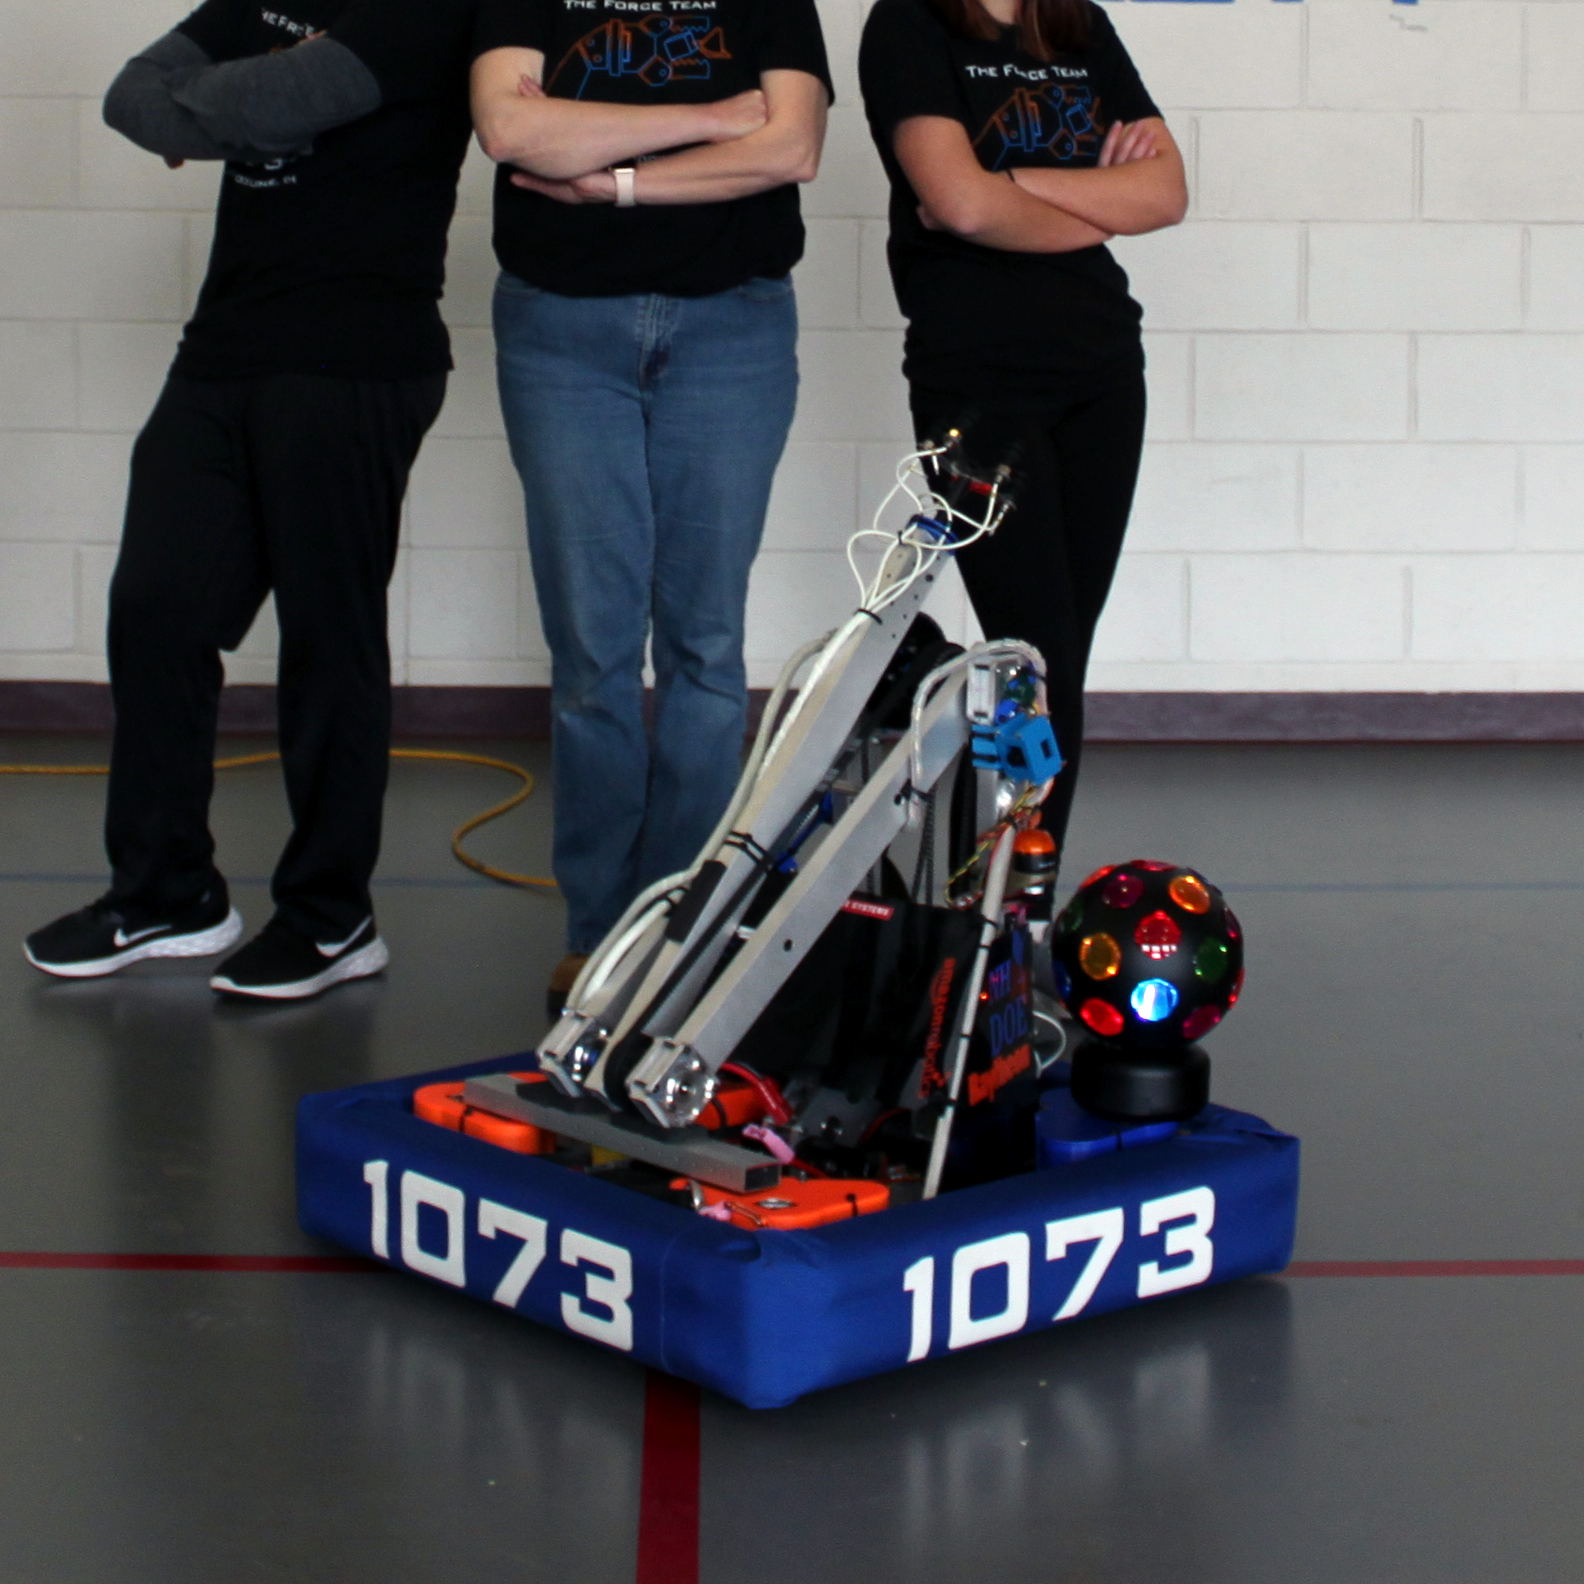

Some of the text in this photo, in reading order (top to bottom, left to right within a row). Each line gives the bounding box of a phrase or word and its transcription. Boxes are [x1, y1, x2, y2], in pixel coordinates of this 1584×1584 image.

[669, 0, 717, 11] TEAM
[966, 65, 999, 78] THE
[1052, 66, 1088, 79] TEAM
[363, 1160, 633, 1352] 1073
[903, 1186, 1216, 1362] 1073
